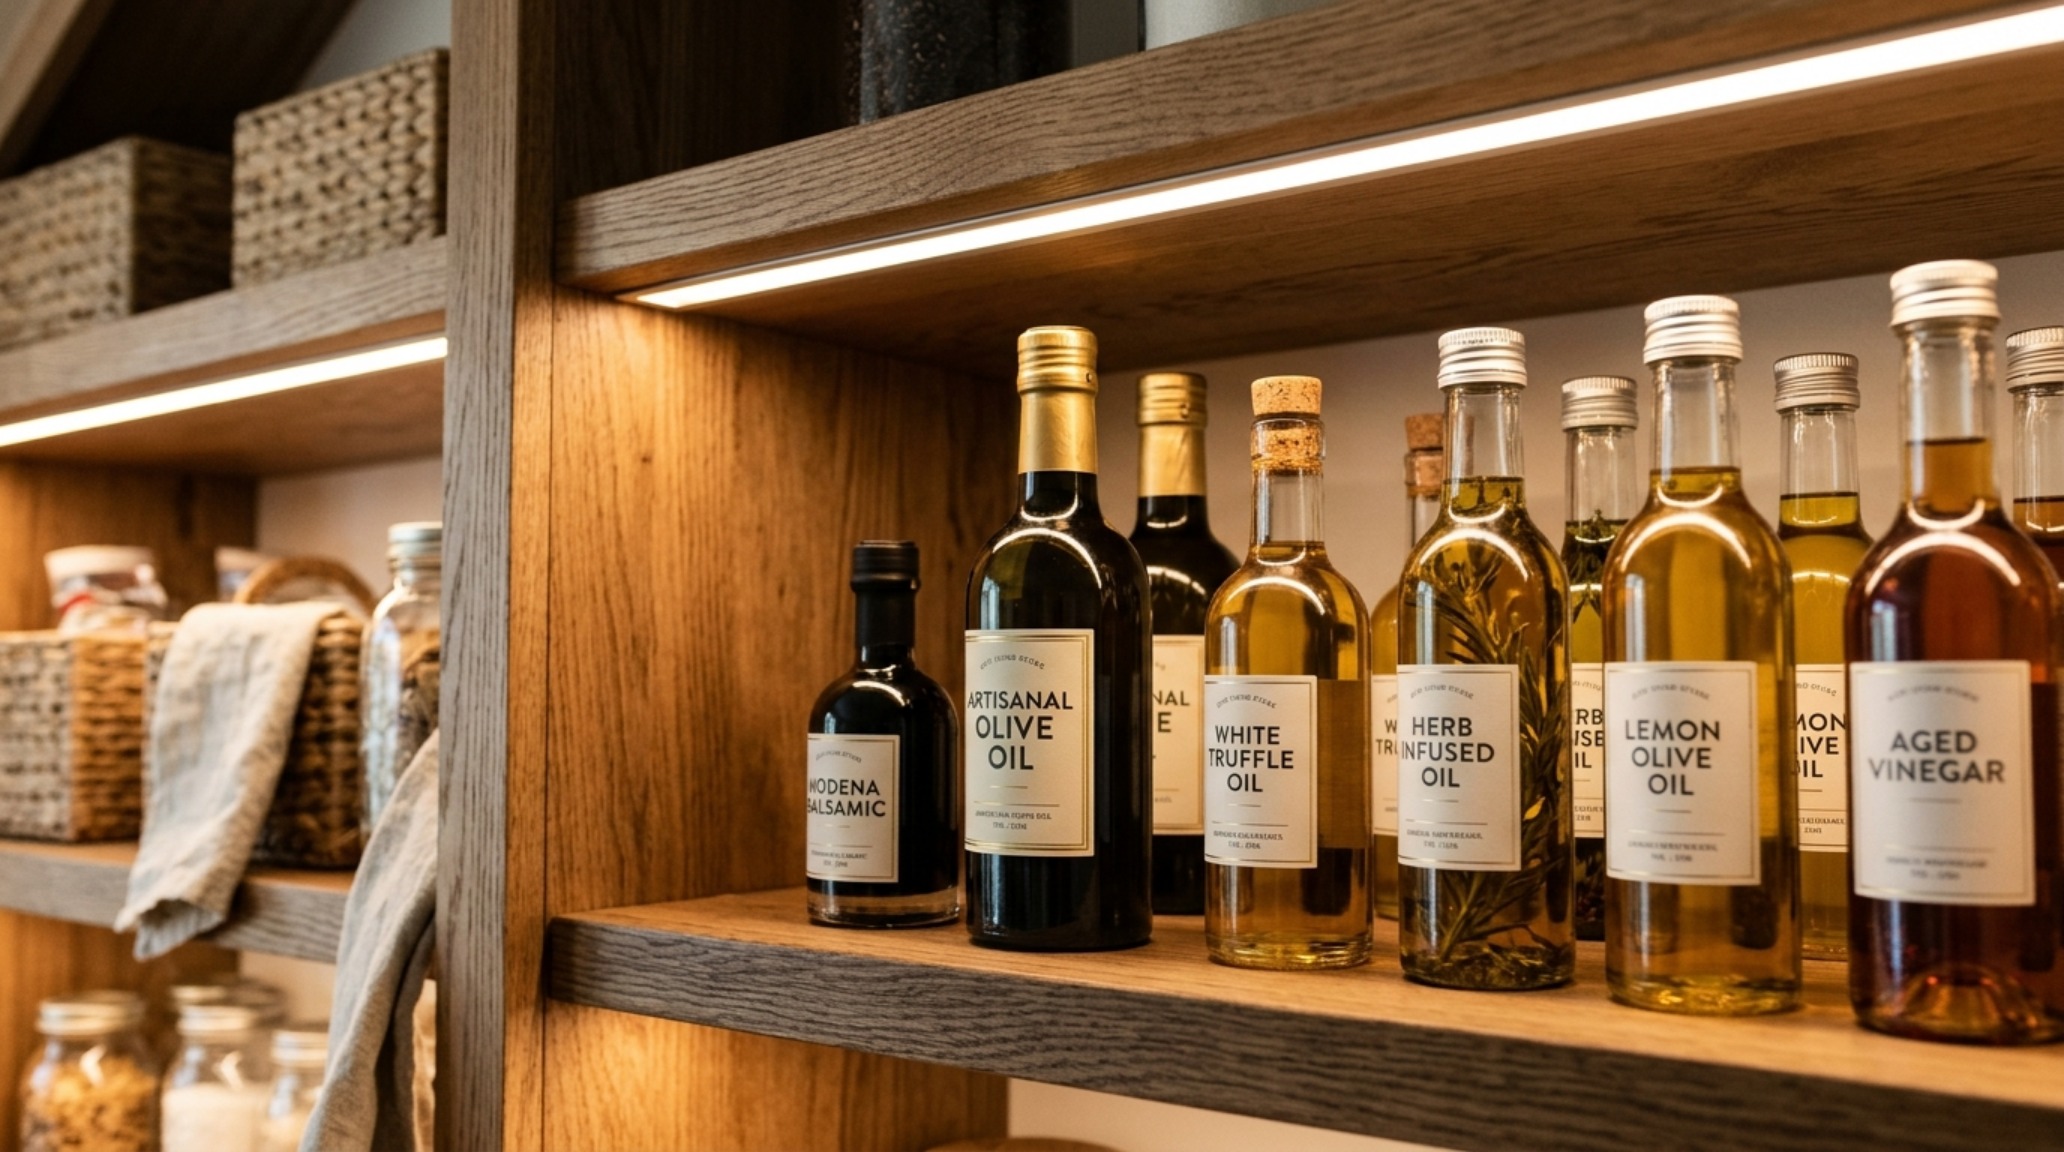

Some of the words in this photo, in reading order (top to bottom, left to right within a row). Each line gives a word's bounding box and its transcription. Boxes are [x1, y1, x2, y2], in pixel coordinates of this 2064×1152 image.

[967, 691, 1073, 710] ARTISANAL
[975, 715, 1053, 740] OLIVE
[1215, 725, 1280, 745] WHITE
[1412, 716, 1473, 737] HERB
[1625, 719, 1720, 742] LEMON
[1401, 740, 1495, 763] INFUSED
[1890, 730, 1978, 755] AGED
[988, 745, 1034, 770] OIL
[1208, 748, 1294, 769] TRUFFLE
[1631, 746, 1712, 769] OLIVE
[1421, 767, 1460, 788] OIL
[1868, 758, 2006, 784] VINEGAR
[1227, 773, 1263, 793] OIL
[1647, 773, 1695, 796] OIL
